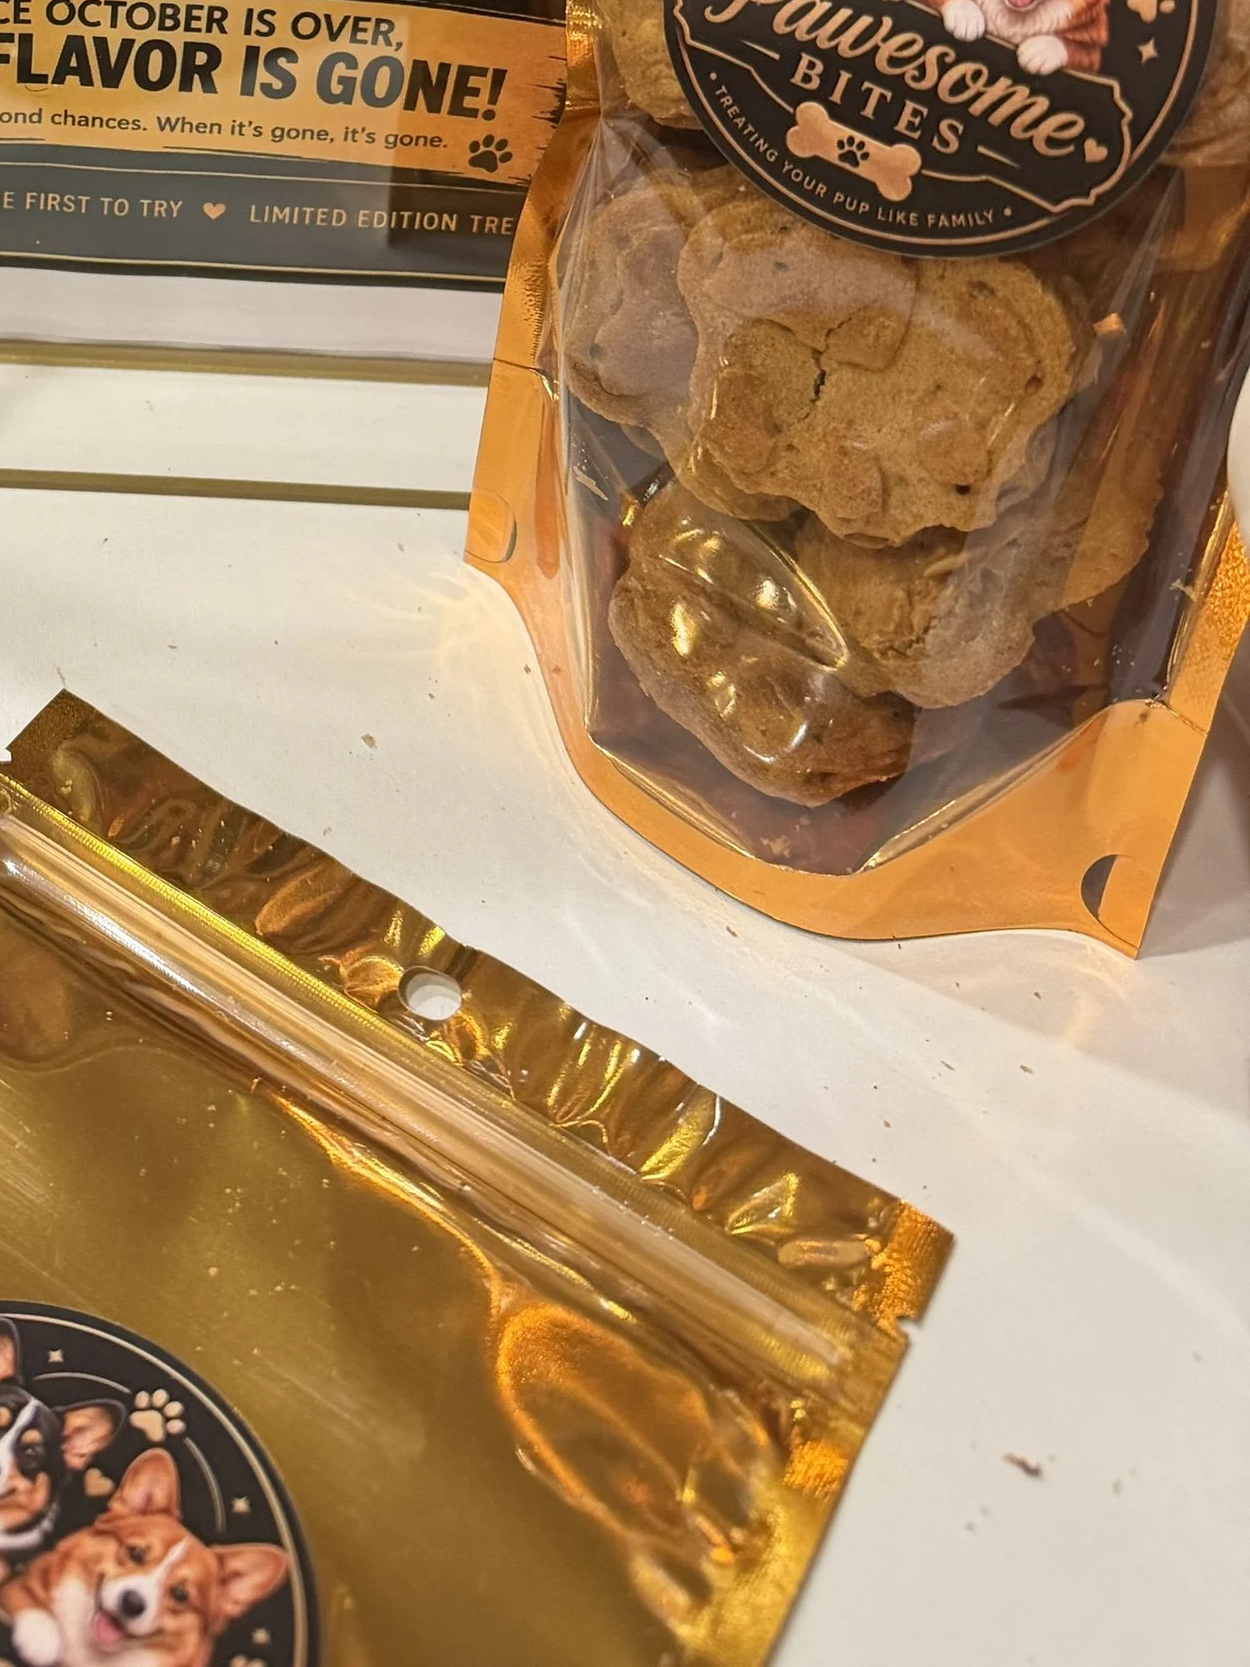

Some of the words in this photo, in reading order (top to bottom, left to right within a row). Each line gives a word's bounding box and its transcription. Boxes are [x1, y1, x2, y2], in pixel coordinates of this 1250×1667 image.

[243, 8, 277, 37] IS
[290, 11, 404, 52] OVER,
[239, 45, 299, 100] IS
[315, 51, 508, 121] GONE!
[791, 52, 966, 155] BITES
[50, 110, 148, 131] chances.
[156, 116, 222, 135] When
[230, 119, 264, 137] it's
[270, 125, 336, 144] gone,
[343, 126, 377, 145] it's
[384, 132, 449, 149] gone.
[713, 84, 778, 163] TREATING
[781, 160, 828, 199] YOUR
[833, 191, 871, 215] PUP
[877, 206, 919, 227] LIKE
[927, 208, 994, 228] FAMILY
[24, 193, 91, 213] FIRST
[100, 197, 129, 216] TO
[139, 199, 183, 218] TRY
[250, 205, 347, 226] LIMITED
[357, 210, 458, 231] EDITION
[470, 215, 516, 235] TRE
